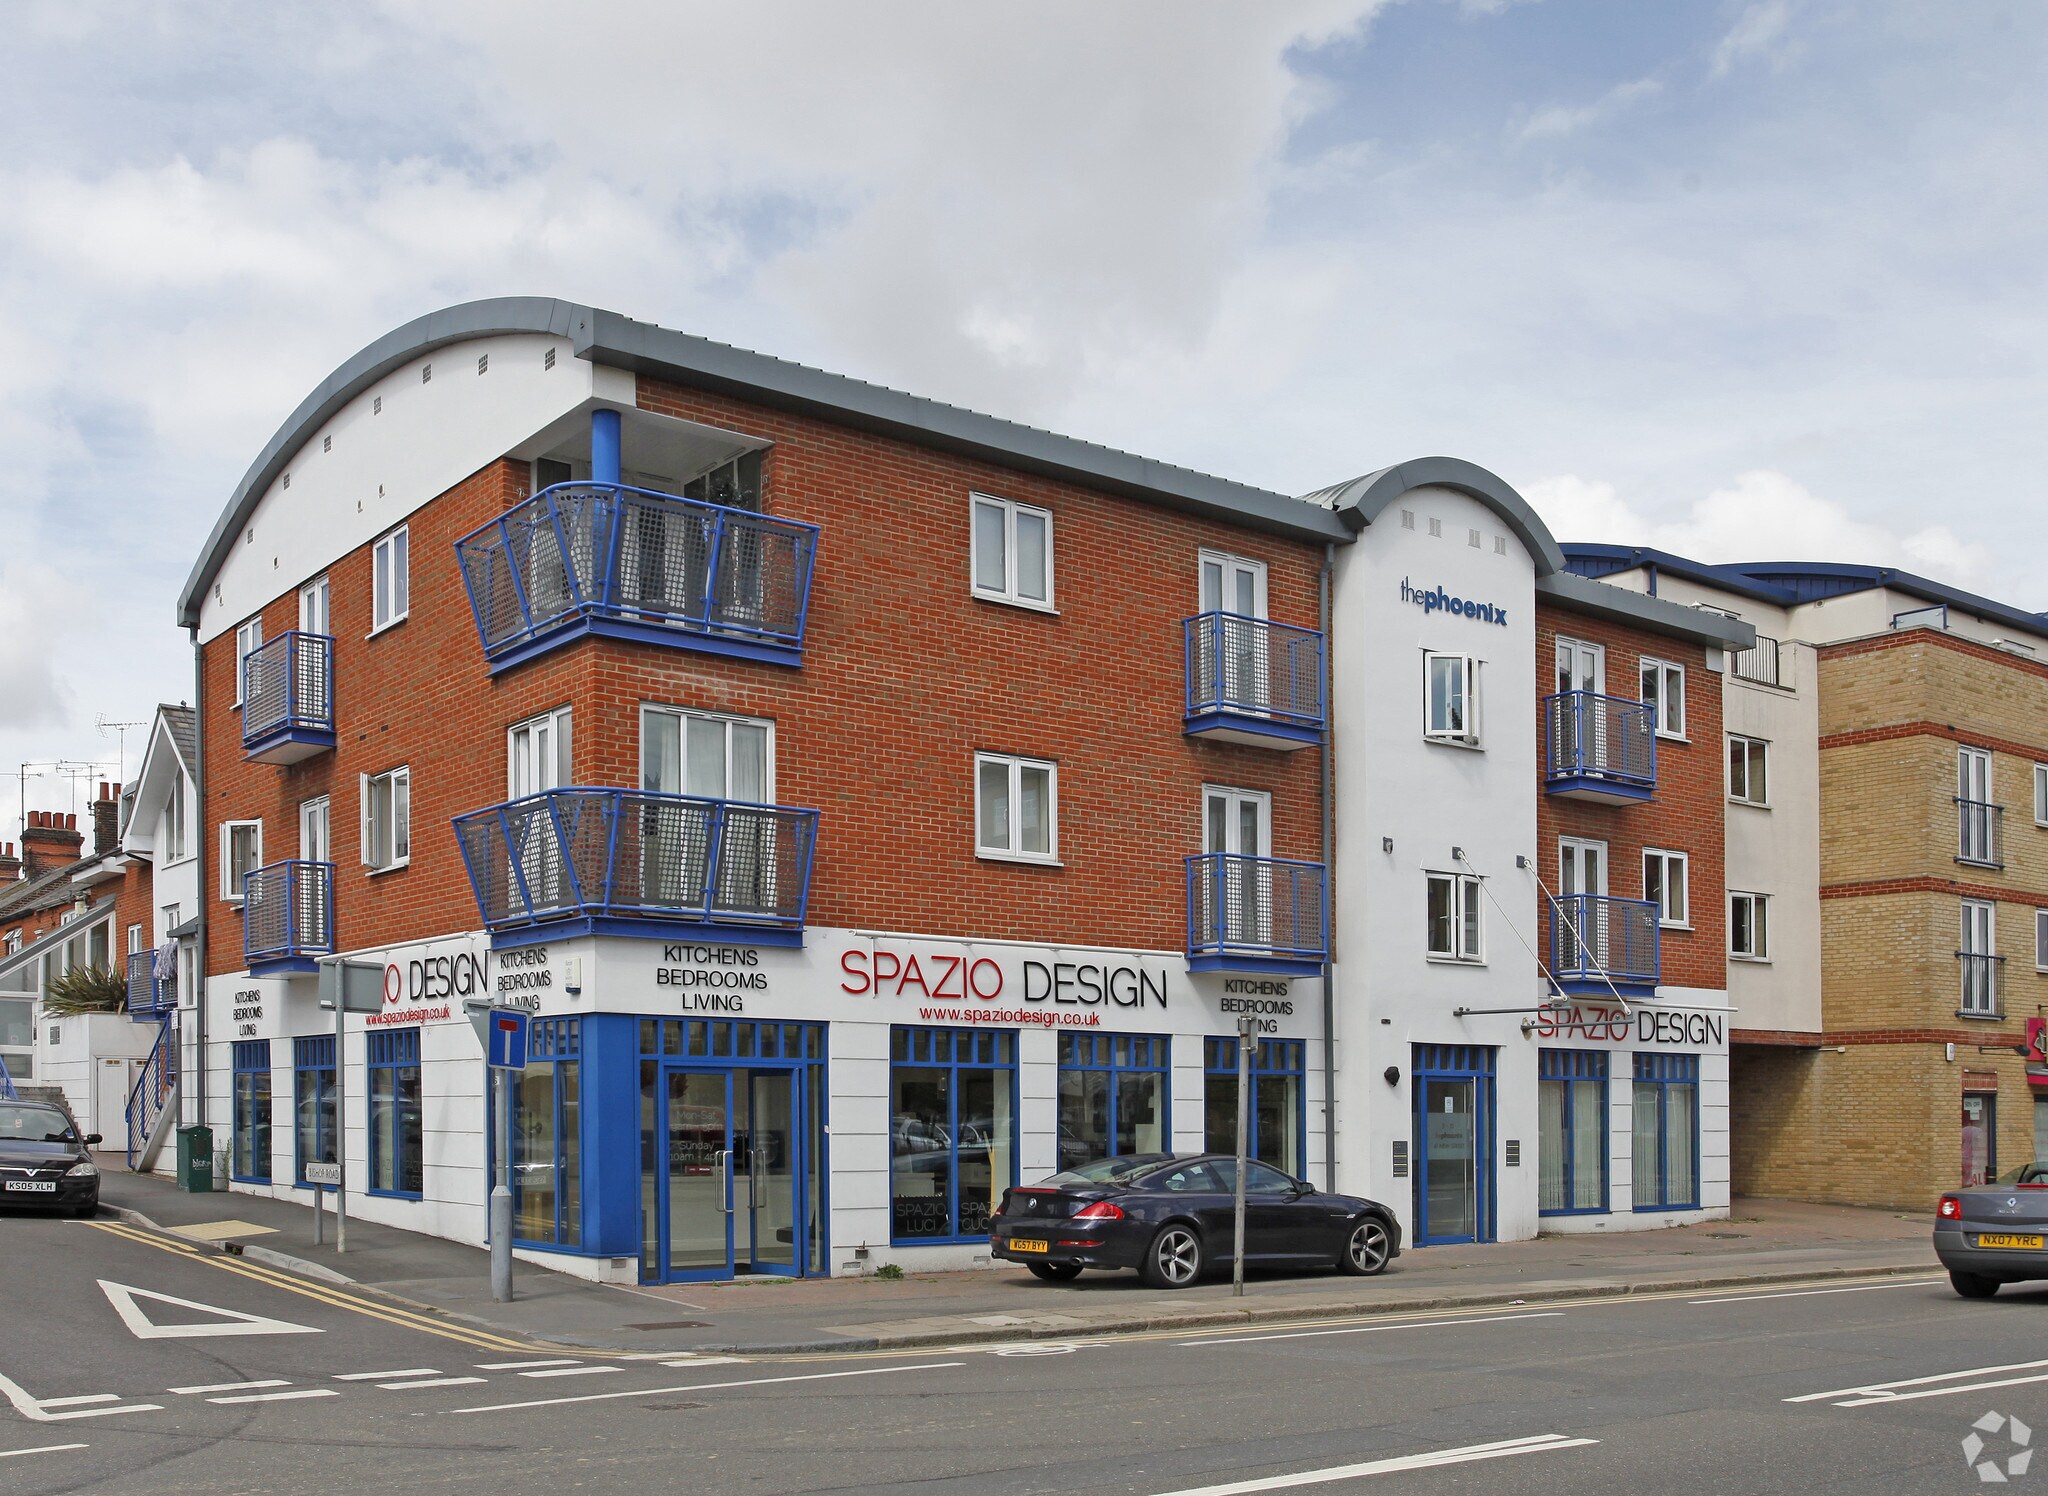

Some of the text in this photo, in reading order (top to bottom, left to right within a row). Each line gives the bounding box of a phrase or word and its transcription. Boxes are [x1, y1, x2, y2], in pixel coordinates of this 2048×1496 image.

[500, 948, 548, 969] KITCHENS
[665, 945, 759, 966] KITCHENS
[409, 950, 488, 1000] DESIGN
[498, 970, 552, 991] BEDROOMS
[657, 968, 768, 990] BEDROOMS
[840, 950, 1167, 1008] SPAZIO DESIGN
[1225, 979, 1288, 996] KITCHENS
[234, 989, 261, 1003] KITCHENS
[682, 993, 743, 1011] LIVING
[233, 1006, 263, 1020] BEDROOMS
[1221, 998, 1294, 1015] BEDROOMS
[364, 1004, 451, 1026] www.spaziodesign.co.uk
[920, 1007, 1101, 1027] www.spaziodesign.co.uk
[239, 1024, 256, 1035] LIVING
[1238, 1018, 1278, 1032] LING
[1538, 1004, 1722, 1045] SPAZIO DESIGN
[680, 1141, 715, 1151] Sunday
[10, 1182, 53, 1190] KS05 XLH
[896, 1203, 946, 1216] SPAZIO
[961, 1202, 997, 1215] SPAZ
[906, 1219, 936, 1233] LUCI
[961, 1217, 989, 1231] CUC
[1032, 1241, 1047, 1250] BYY
[1983, 1235, 2037, 1246] NX07 YRC
